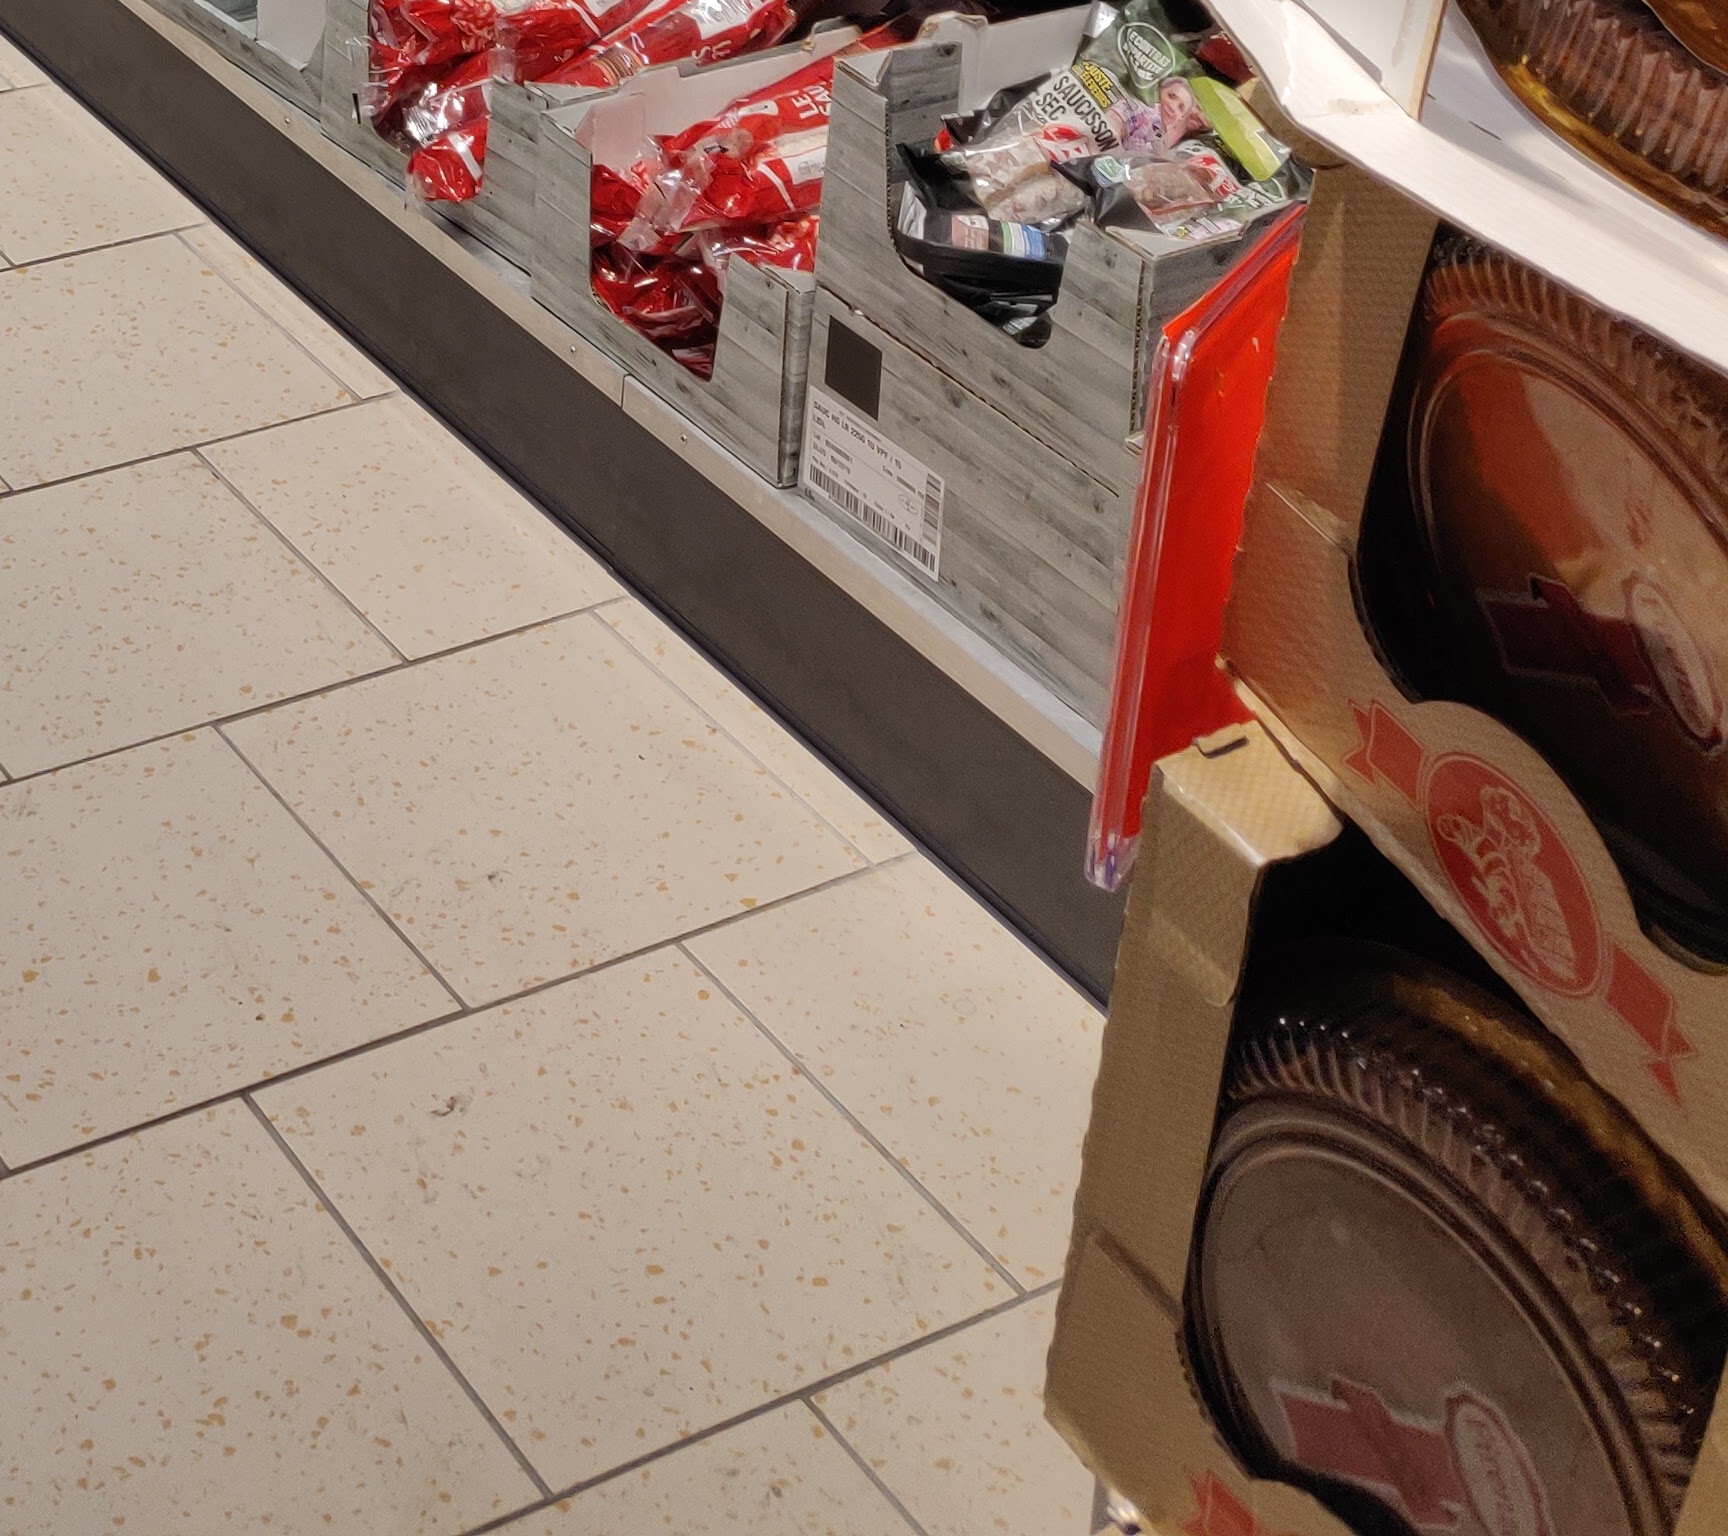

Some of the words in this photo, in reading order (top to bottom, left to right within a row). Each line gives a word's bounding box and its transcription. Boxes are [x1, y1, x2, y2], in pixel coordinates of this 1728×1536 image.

[803, 85, 833, 117] SAU
[1036, 91, 1067, 122] SEC
[1053, 75, 1119, 152] SAUCISSON
